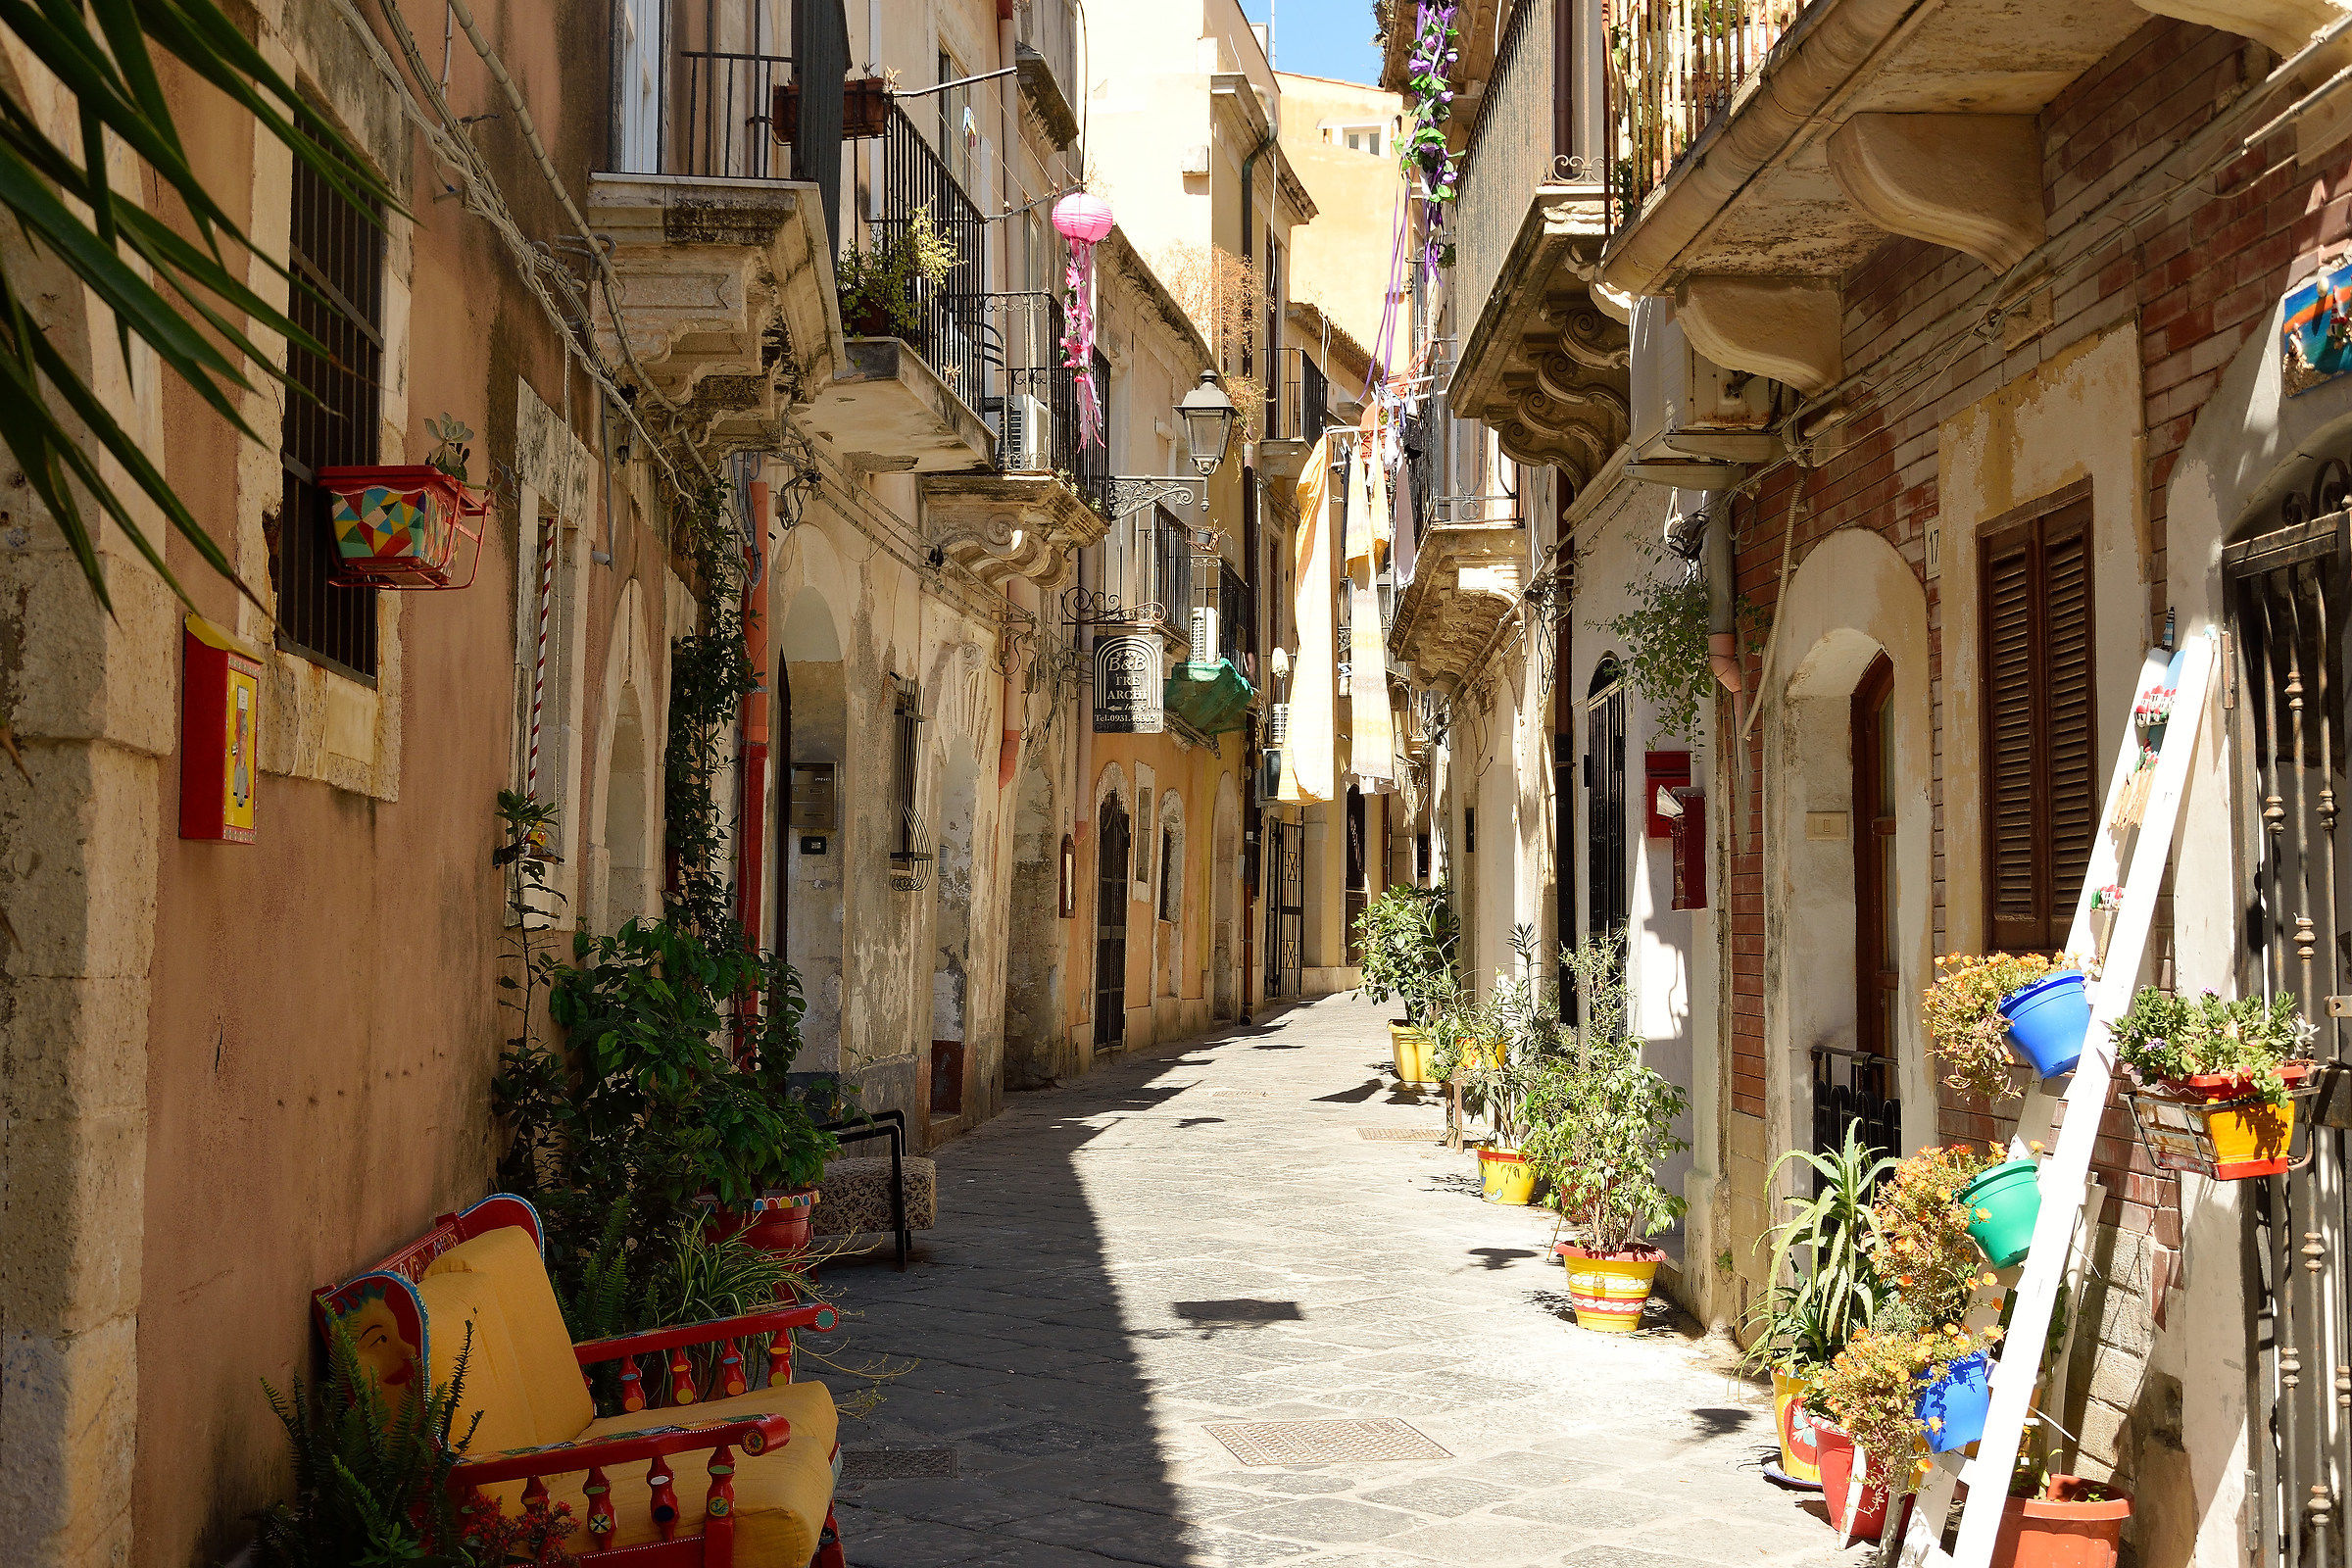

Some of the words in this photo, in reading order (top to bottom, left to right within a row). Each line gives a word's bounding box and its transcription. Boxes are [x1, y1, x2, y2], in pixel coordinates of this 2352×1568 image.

[1929, 528, 1939, 565] 17
[1108, 657, 1147, 671] B&B
[1115, 674, 1140, 686] TRE
[1107, 690, 1147, 702] ARCHI
